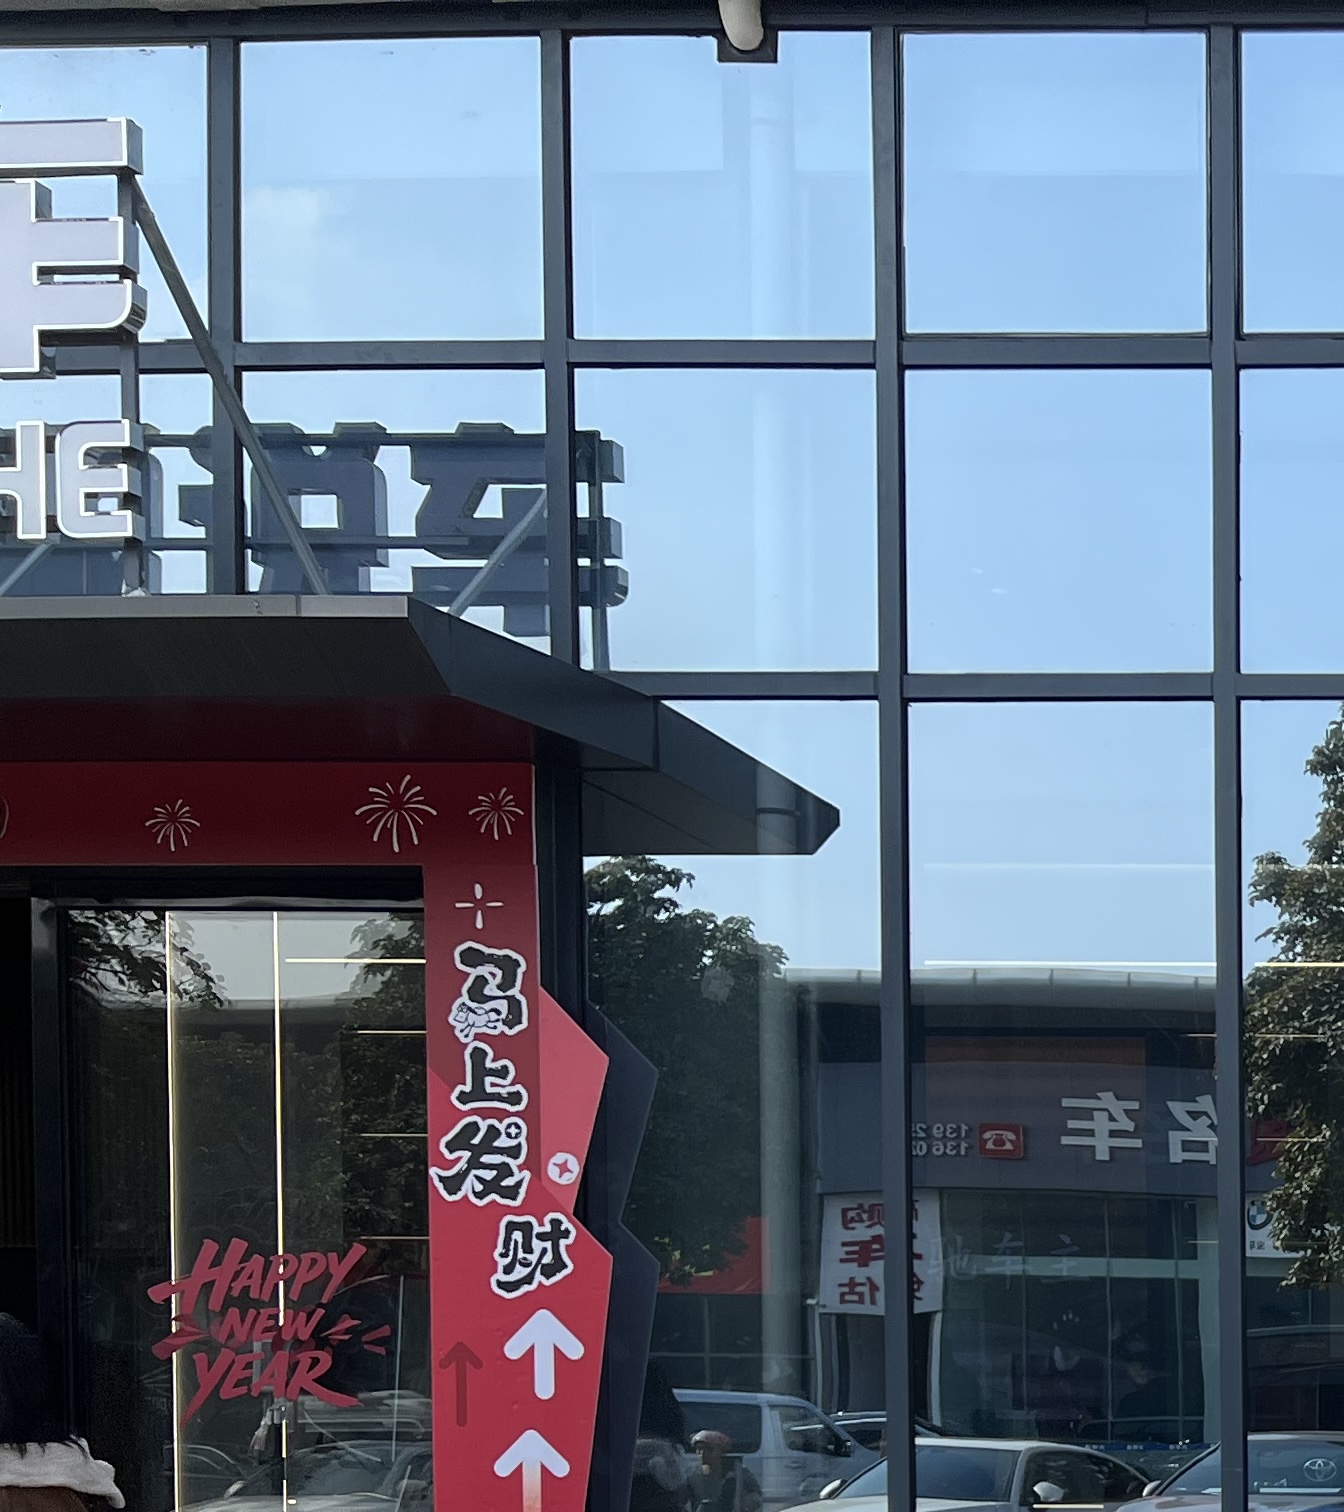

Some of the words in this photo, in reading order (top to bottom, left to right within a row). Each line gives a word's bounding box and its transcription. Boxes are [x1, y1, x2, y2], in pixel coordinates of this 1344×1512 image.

[433, 944, 573, 1296] 马上发财
[148, 1237, 367, 1317] HAPPY
[219, 1307, 325, 1344] NEW
[180, 1348, 365, 1432] YEAR
